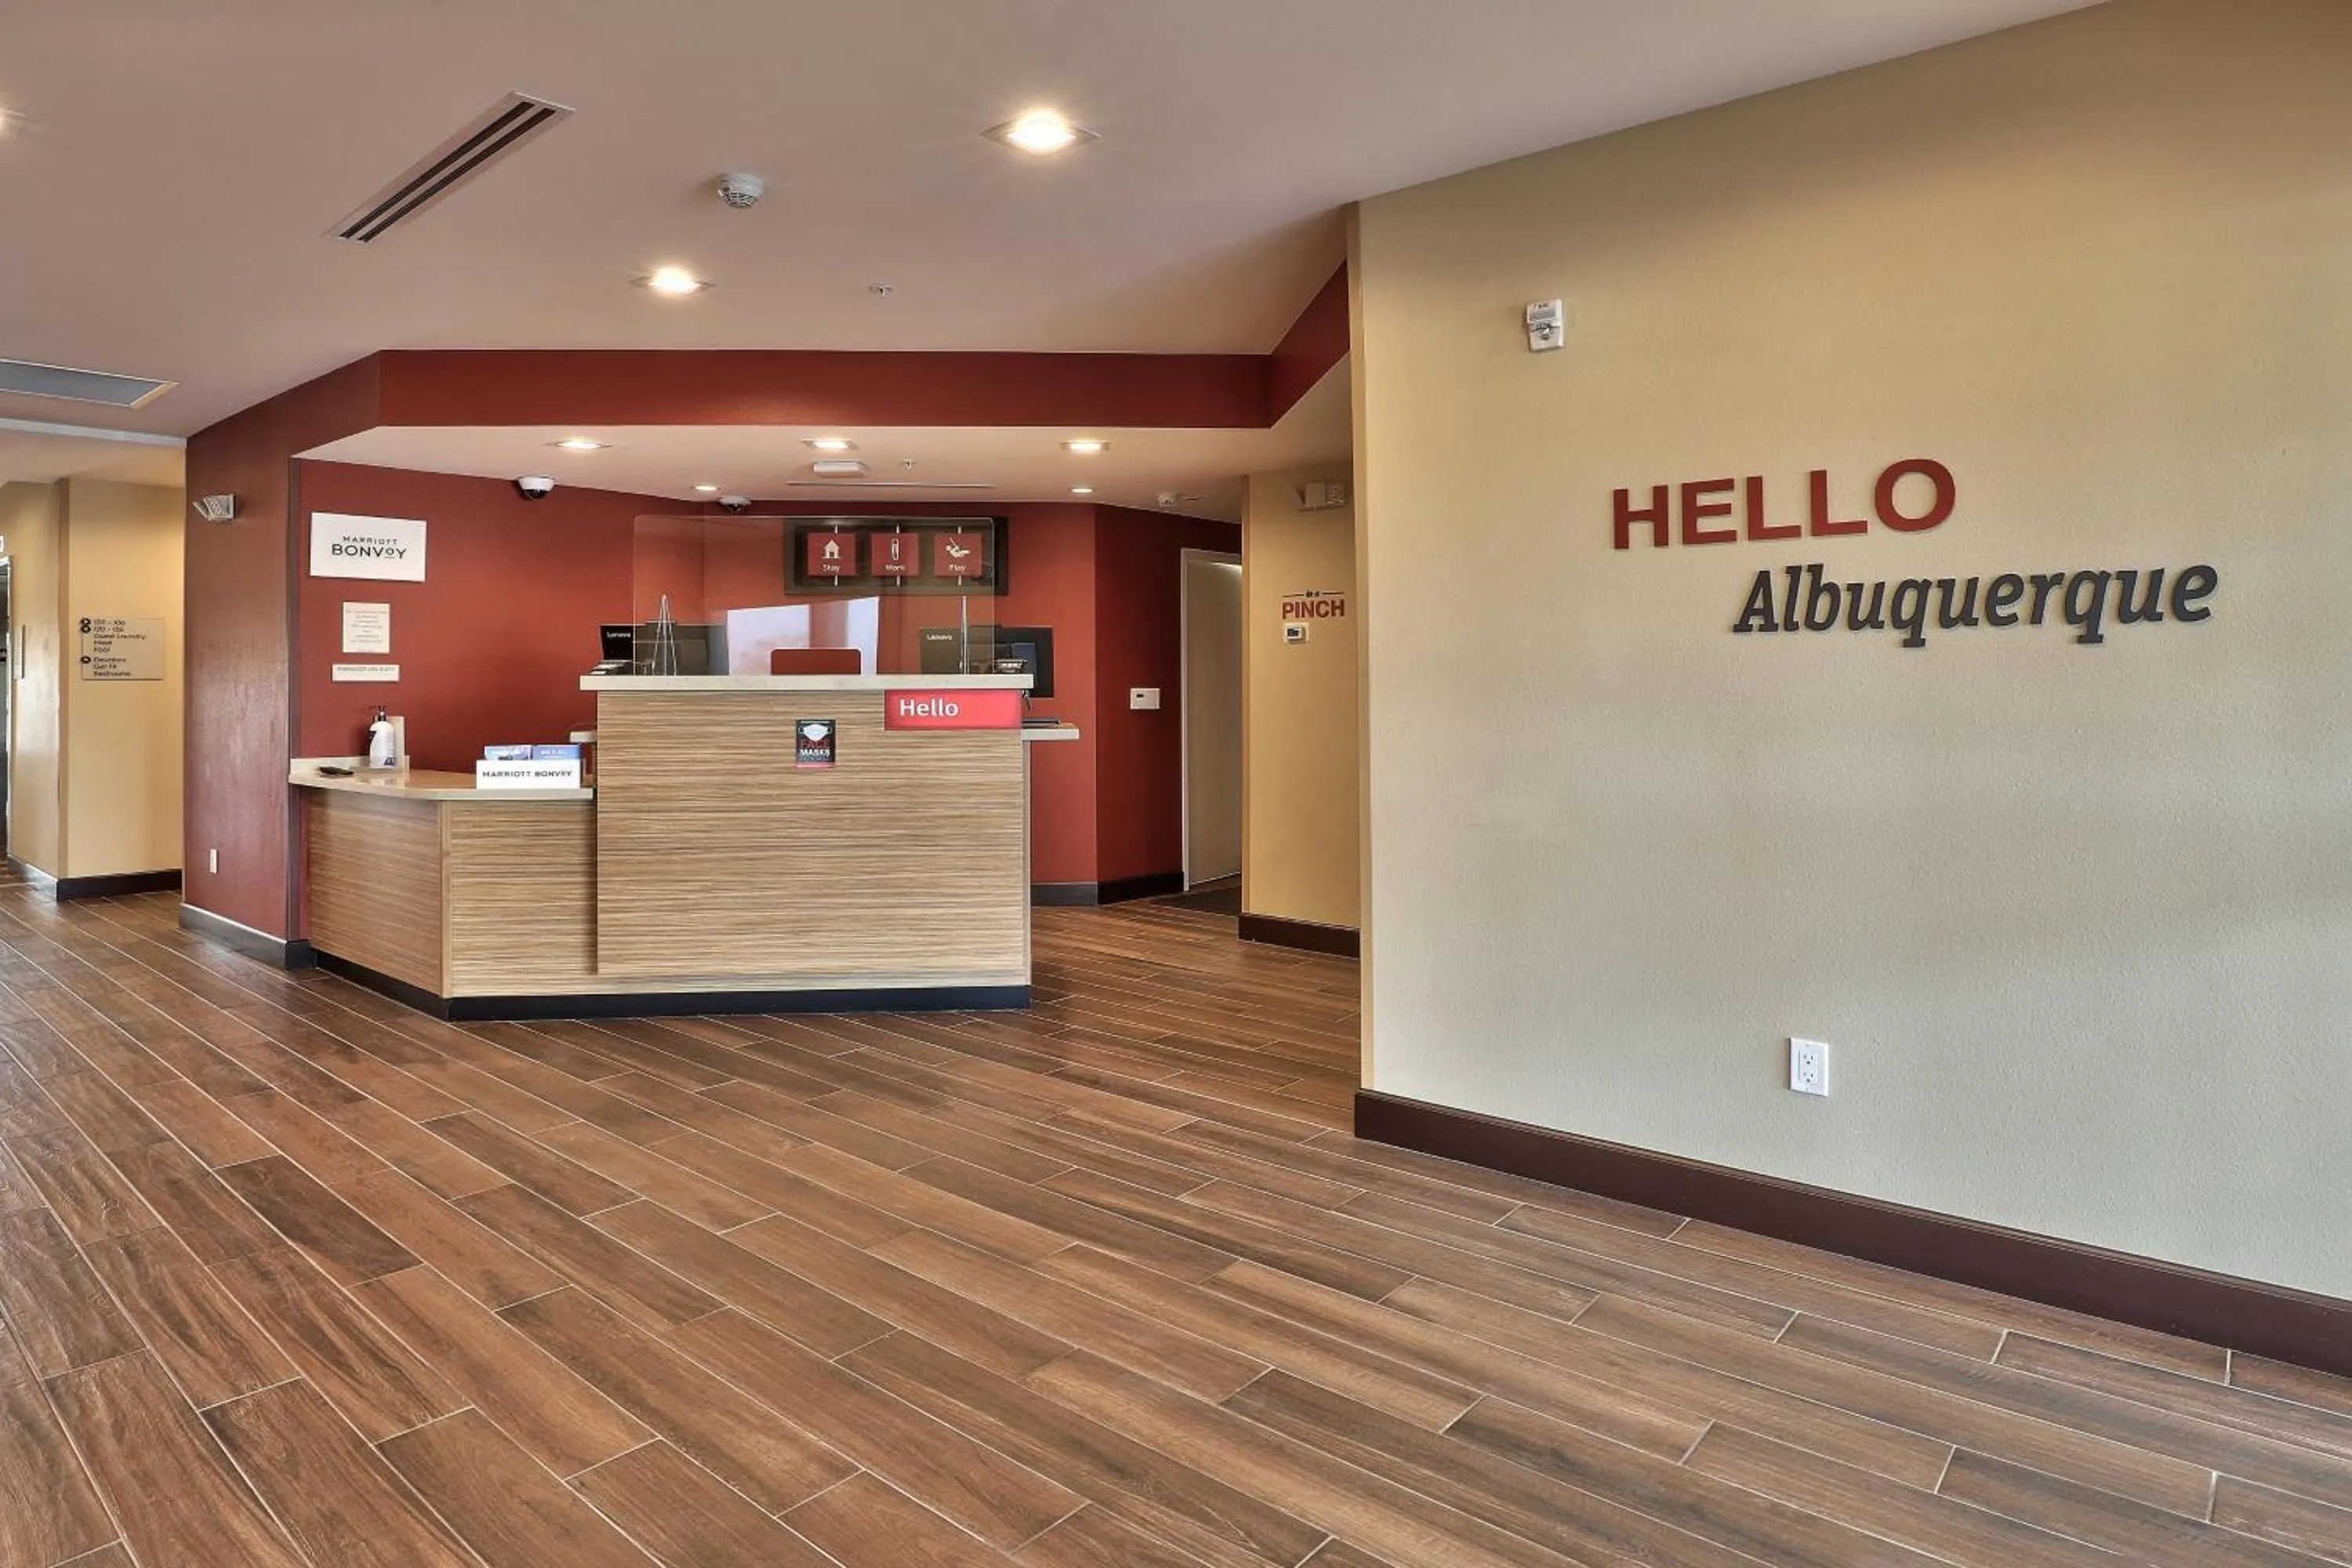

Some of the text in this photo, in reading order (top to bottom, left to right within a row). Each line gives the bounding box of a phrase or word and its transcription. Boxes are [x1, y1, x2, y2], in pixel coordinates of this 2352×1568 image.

[1612, 459, 1956, 550] HELLO
[342, 535, 397, 545] MARRIOTT
[331, 543, 407, 559] BONVOY
[822, 564, 841, 572] Stay
[949, 564, 967, 572] Play
[1282, 599, 1345, 619] PINCH
[1732, 562, 2219, 648] Albuquerque
[899, 699, 960, 717] Hello
